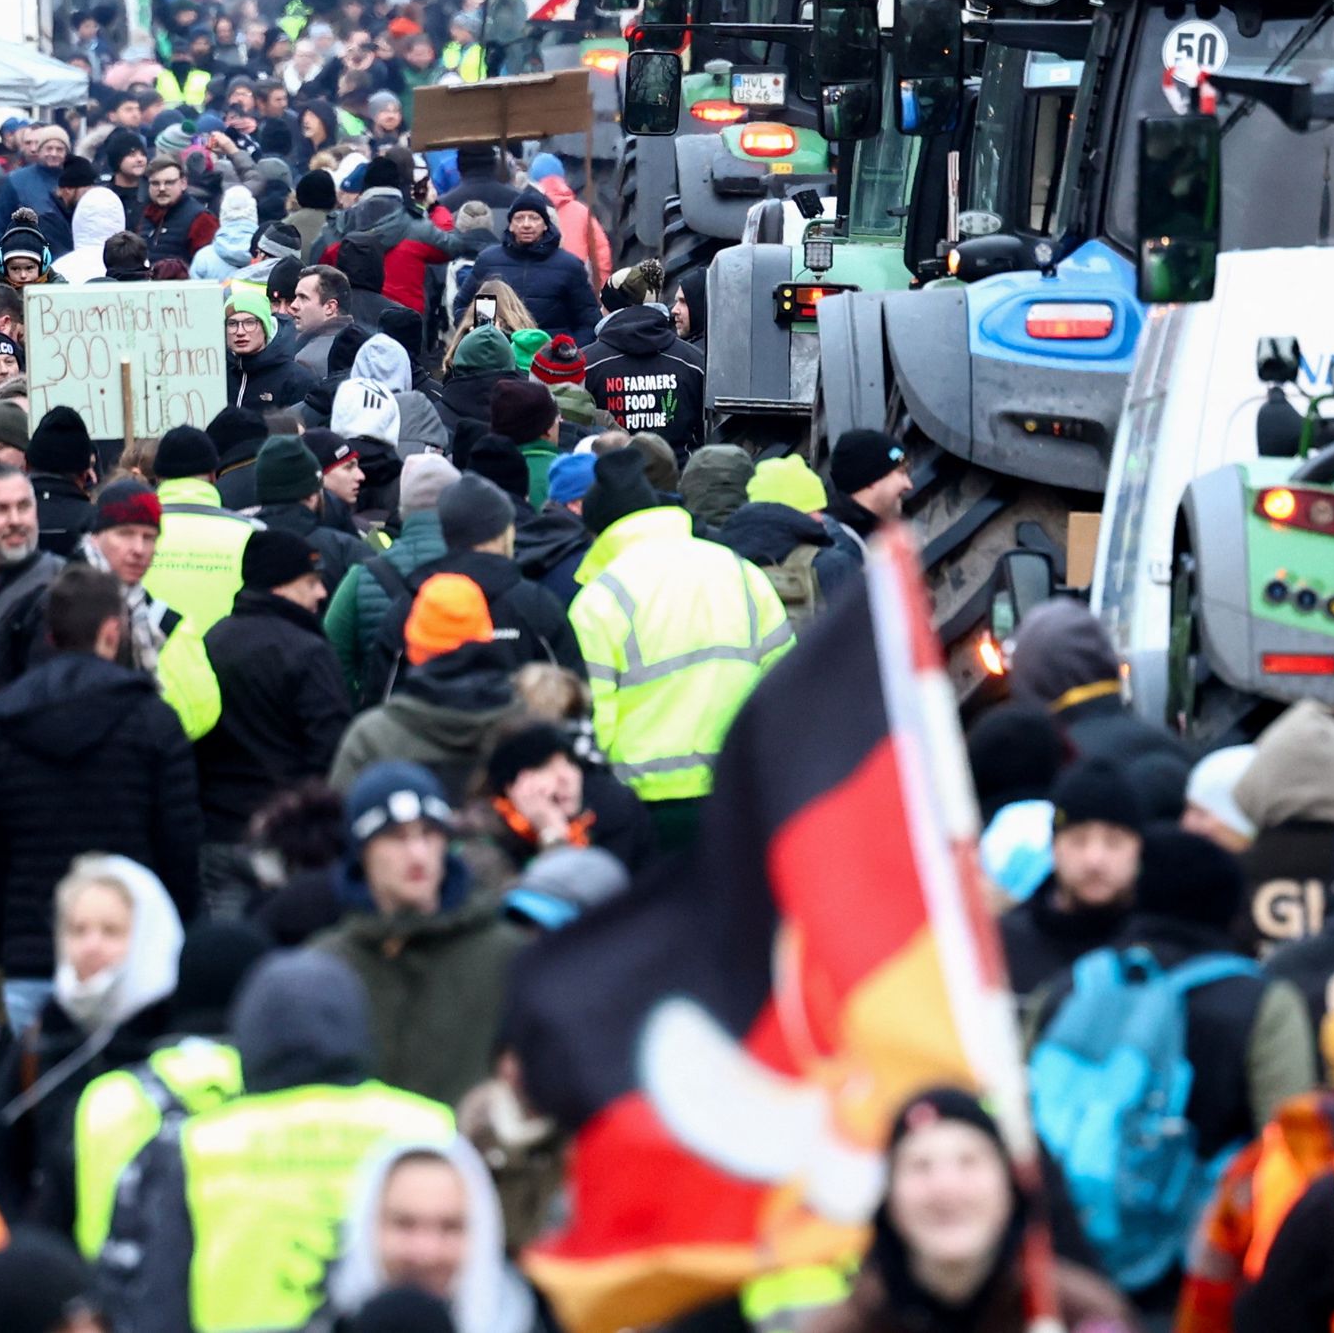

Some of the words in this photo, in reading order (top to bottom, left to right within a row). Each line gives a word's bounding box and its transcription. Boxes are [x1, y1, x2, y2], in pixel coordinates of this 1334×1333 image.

[1176, 32, 1217, 66] 50
[742, 78, 767, 89] HVL
[737, 90, 752, 101] US
[28, 292, 155, 336] Bauernhof
[161, 291, 194, 330] mit
[42, 335, 111, 382] 300
[606, 377, 623, 392] NO
[623, 374, 677, 391] FARMERS
[607, 396, 623, 411] NO
[624, 394, 656, 411] FOOD
[625, 412, 667, 429] FUTURE
